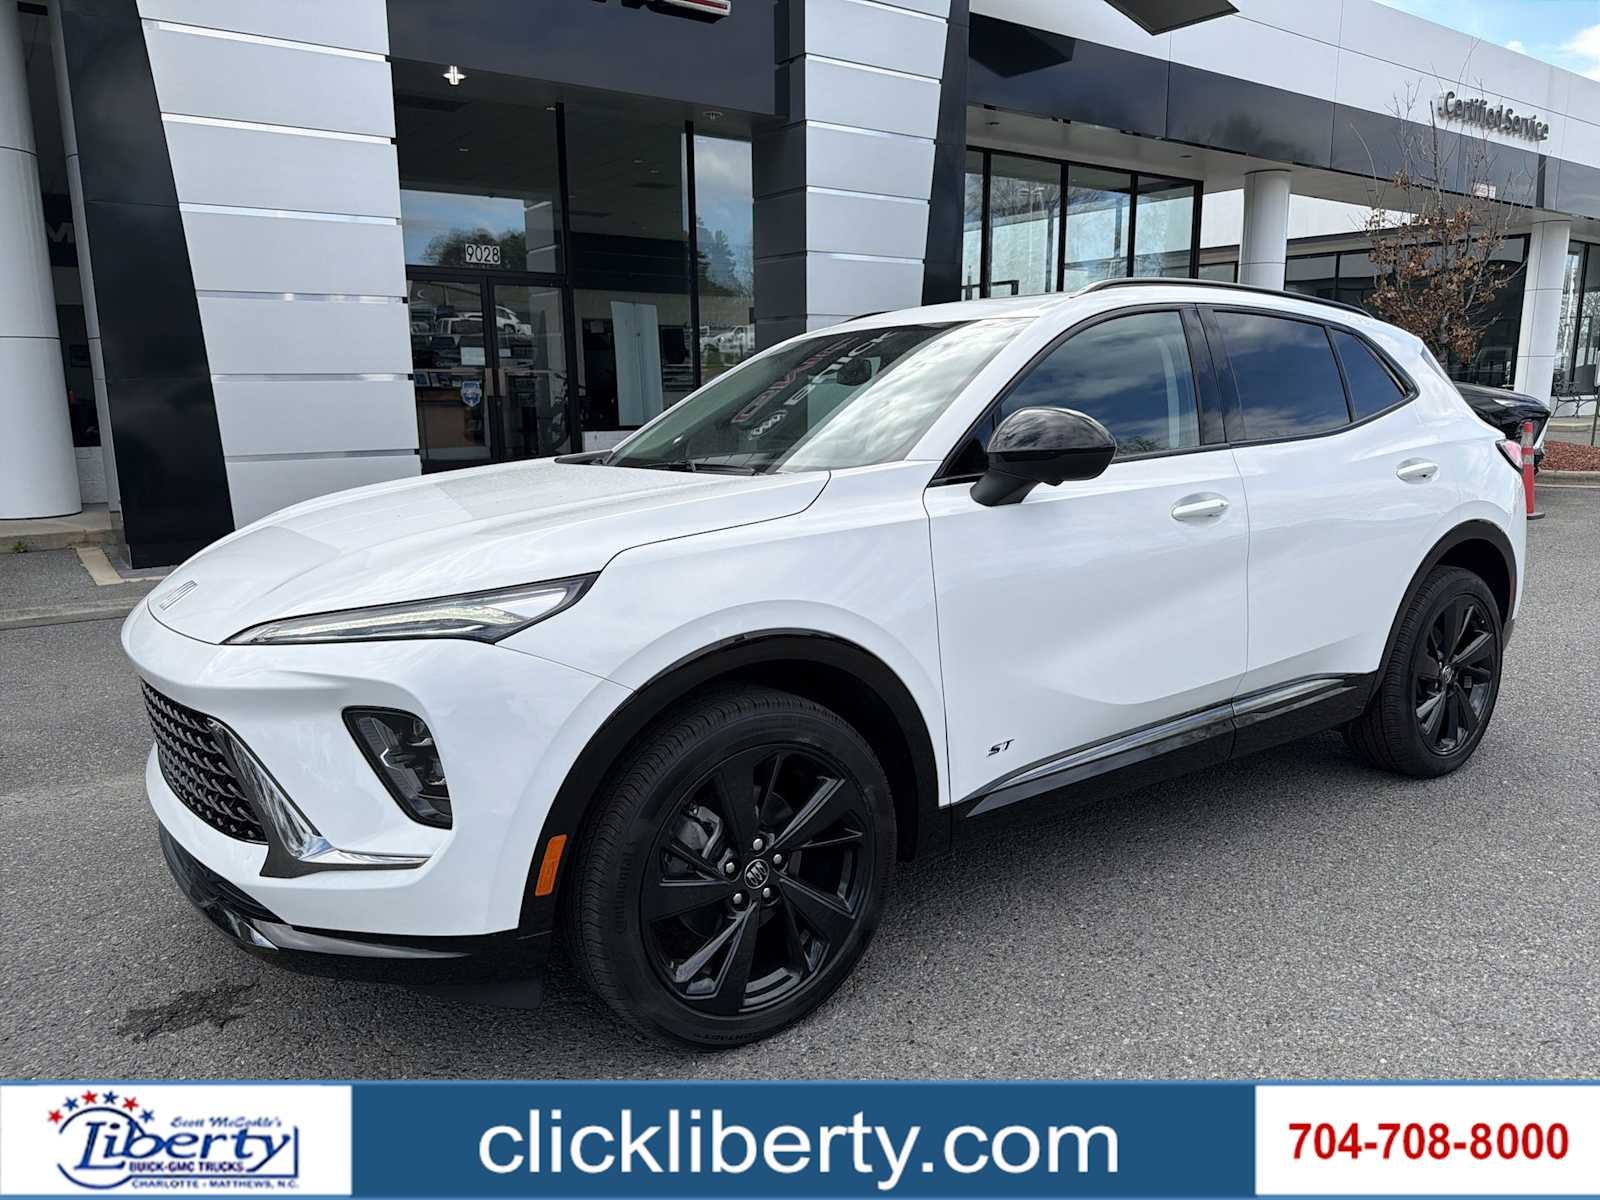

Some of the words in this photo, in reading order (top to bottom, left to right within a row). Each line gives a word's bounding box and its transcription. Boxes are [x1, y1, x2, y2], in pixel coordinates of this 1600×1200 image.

[1444, 91, 1504, 130] Certified
[1504, 108, 1549, 141] Service
[465, 245, 500, 263] 9028
[986, 738, 1015, 757] ST
